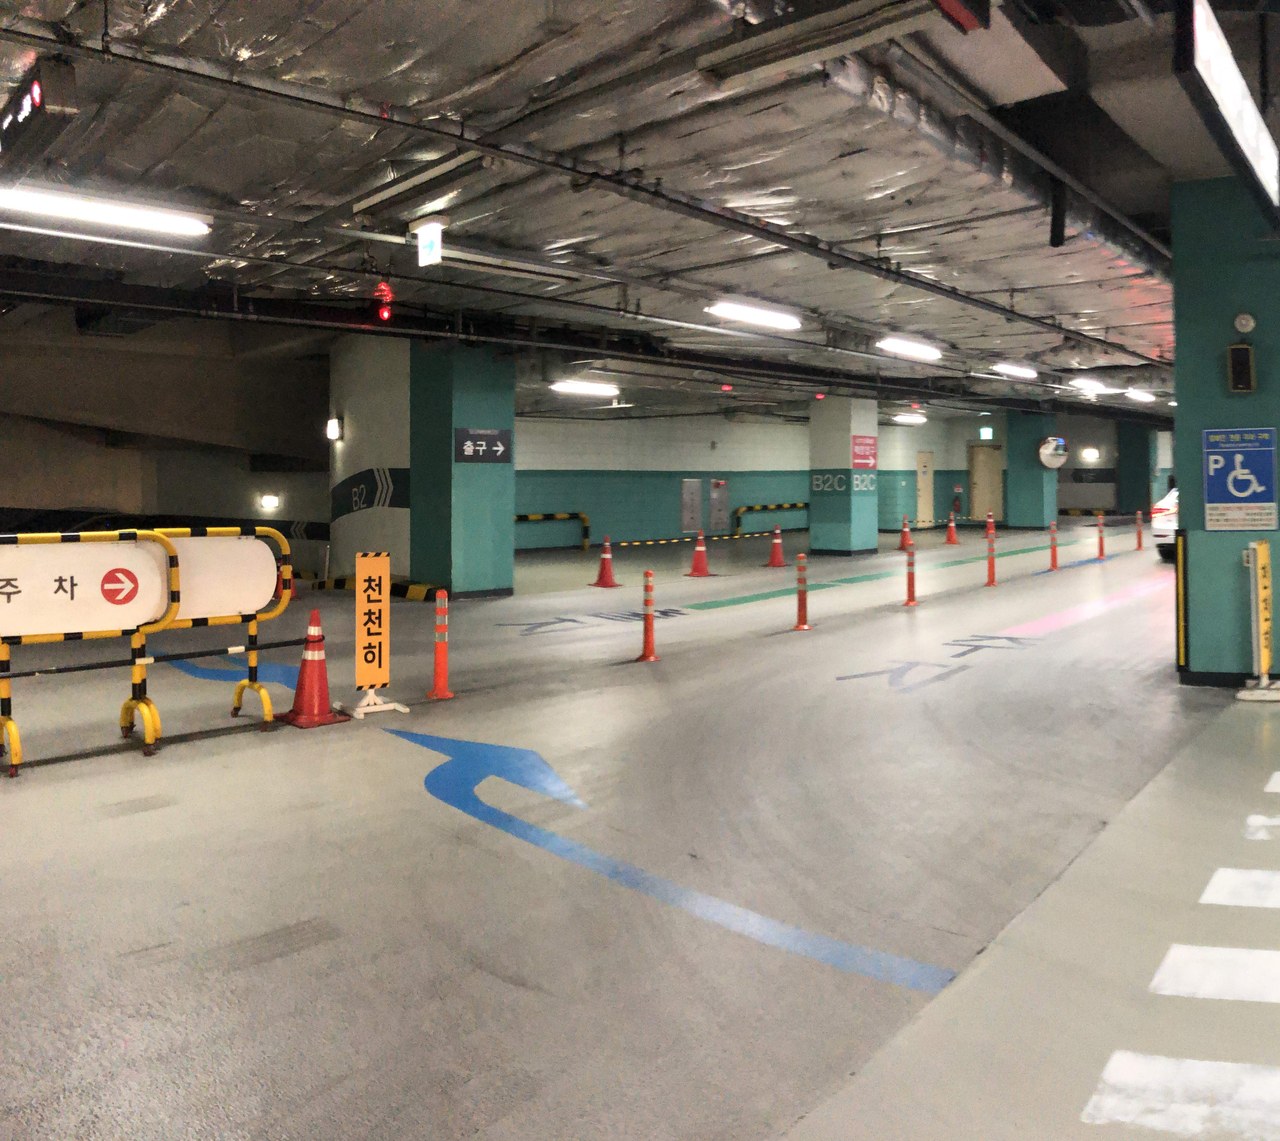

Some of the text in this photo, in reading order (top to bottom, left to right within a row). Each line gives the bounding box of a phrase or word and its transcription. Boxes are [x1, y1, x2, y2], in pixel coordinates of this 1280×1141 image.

[463, 440, 488, 456] 출구
[1208, 454, 1226, 476] P
[812, 474, 847, 492] B2C
[852, 473, 877, 492] B2C
[351, 484, 368, 511] B2
[0, 575, 78, 604] 주 차
[362, 575, 384, 670] 천천히
